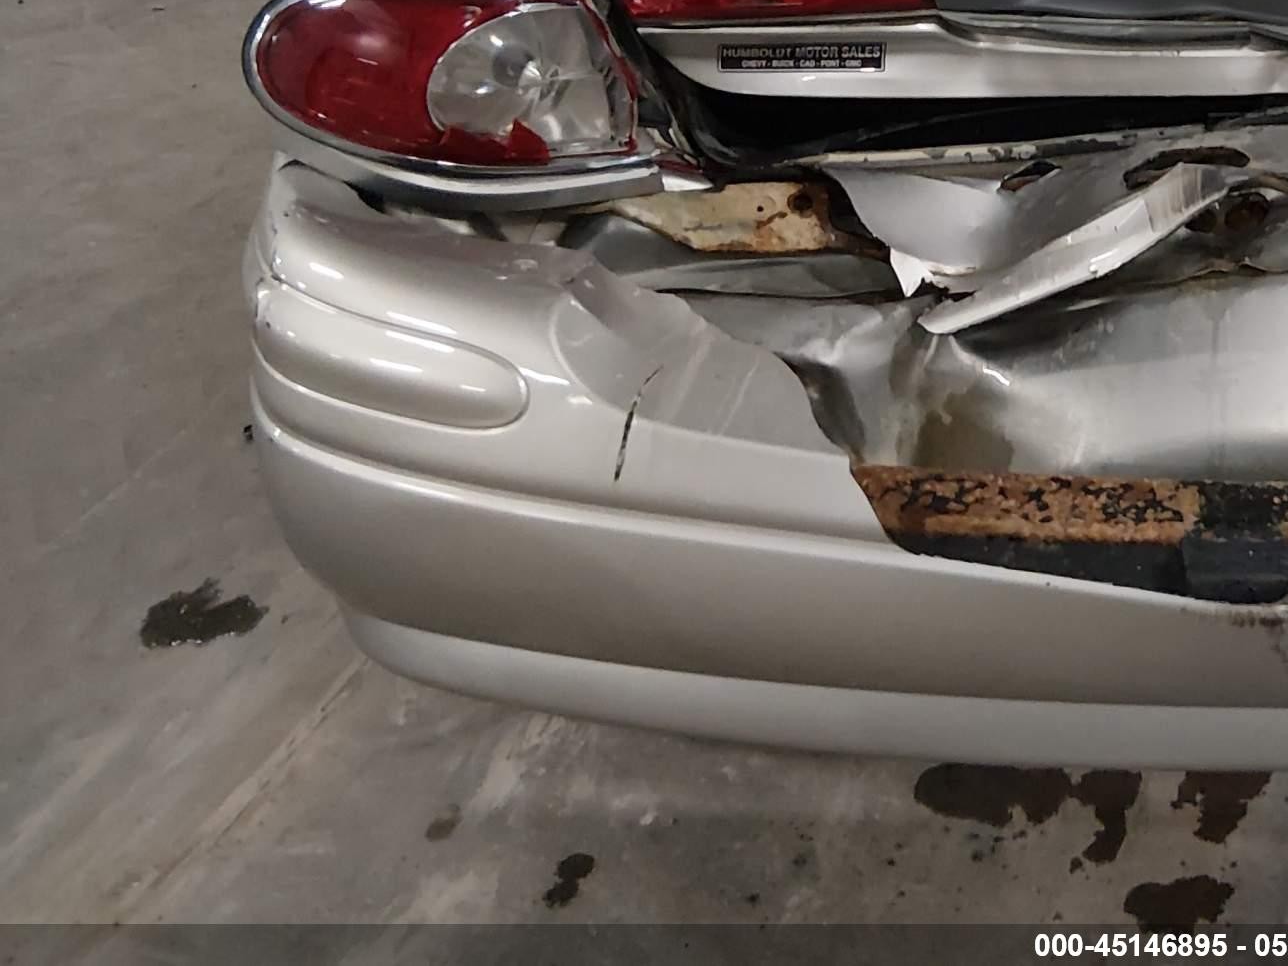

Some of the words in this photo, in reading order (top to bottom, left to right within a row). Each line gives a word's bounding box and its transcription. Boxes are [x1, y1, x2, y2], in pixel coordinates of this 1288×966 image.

[723, 47, 791, 58] HUMBOLDT
[795, 47, 838, 58] MOTOR
[841, 46, 881, 58] SALES
